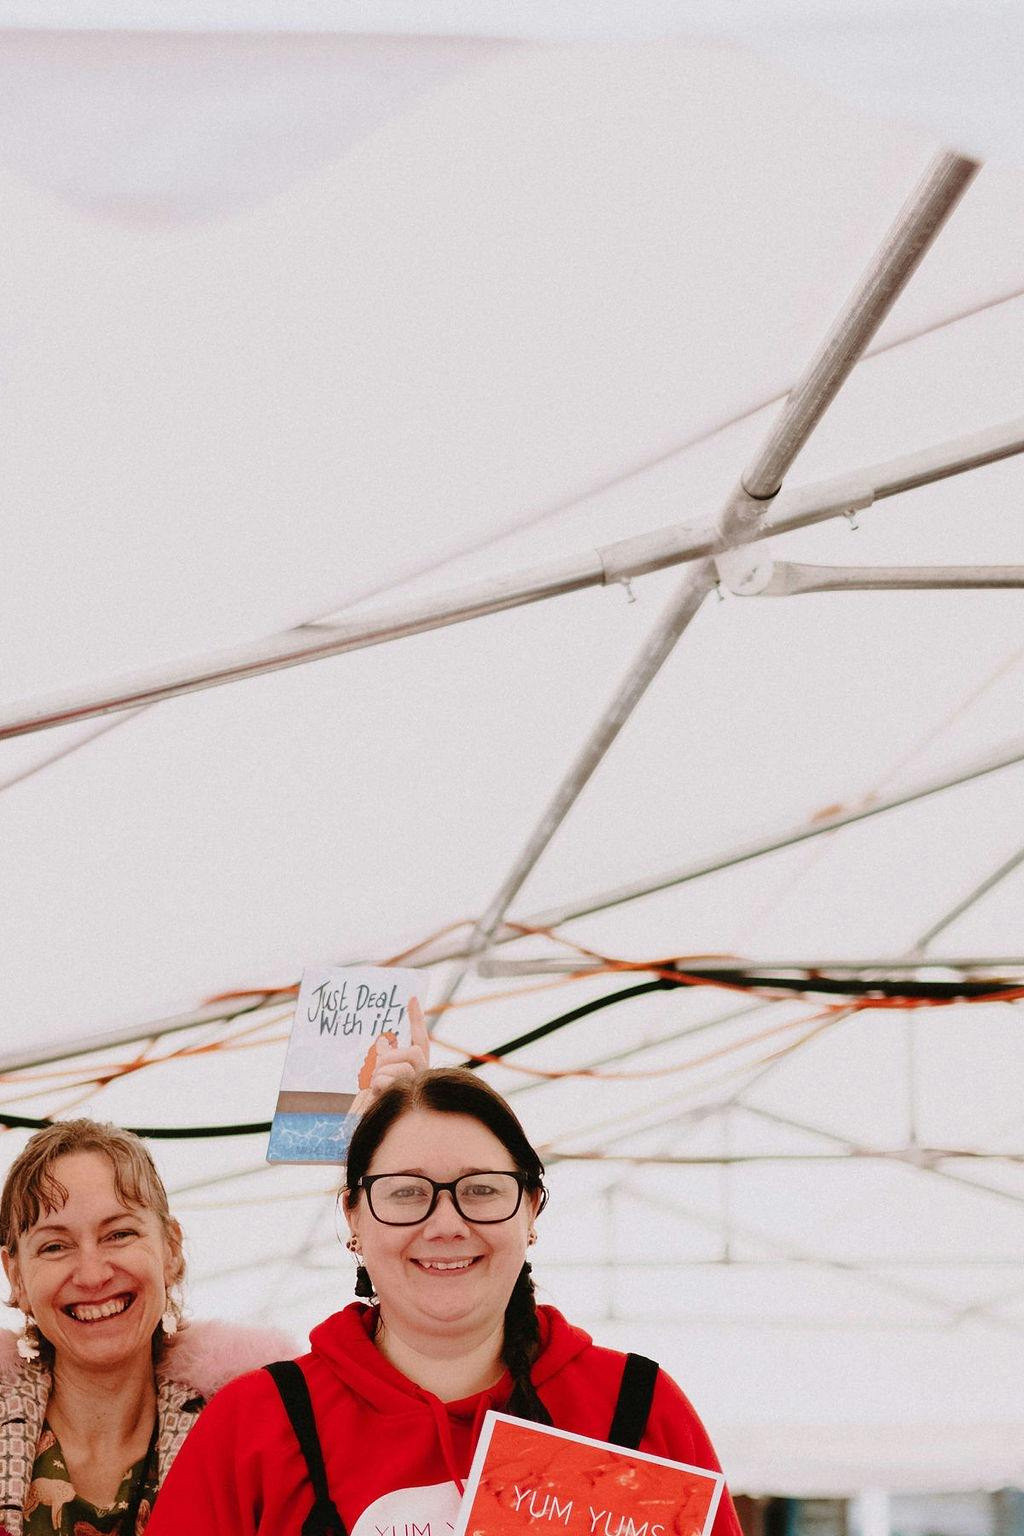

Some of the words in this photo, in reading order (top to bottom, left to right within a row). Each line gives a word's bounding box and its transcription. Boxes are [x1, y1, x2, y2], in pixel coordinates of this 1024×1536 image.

[308, 980, 348, 1022] Just
[319, 1010, 362, 1036] With
[512, 1485, 574, 1527] YUM
